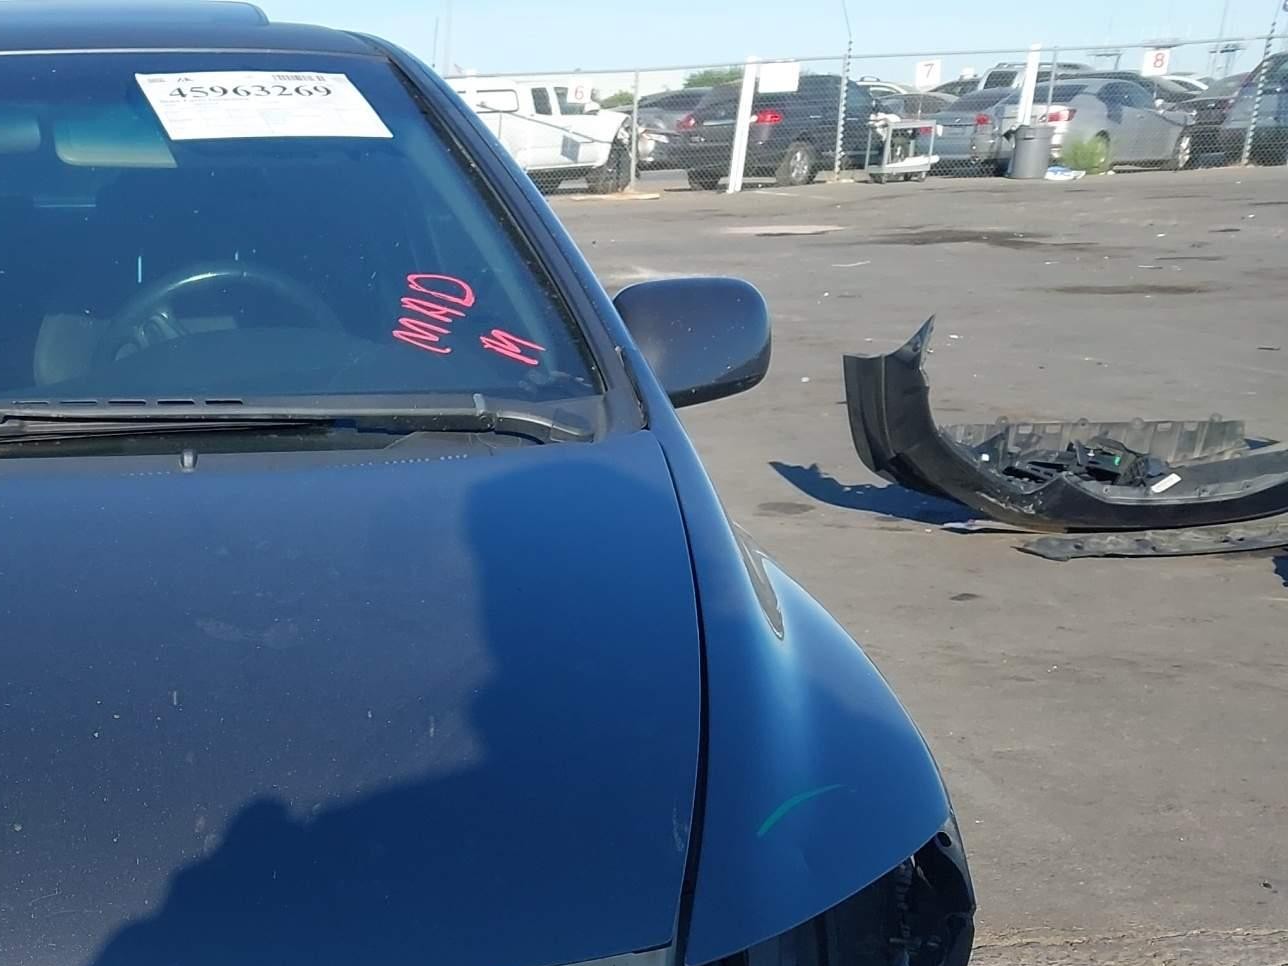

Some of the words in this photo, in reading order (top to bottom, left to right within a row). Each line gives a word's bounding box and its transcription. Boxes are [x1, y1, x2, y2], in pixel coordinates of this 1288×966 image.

[1152, 52, 1165, 69] 8
[923, 63, 934, 79] 7
[169, 85, 332, 98] 45963269
[574, 85, 585, 100] 6
